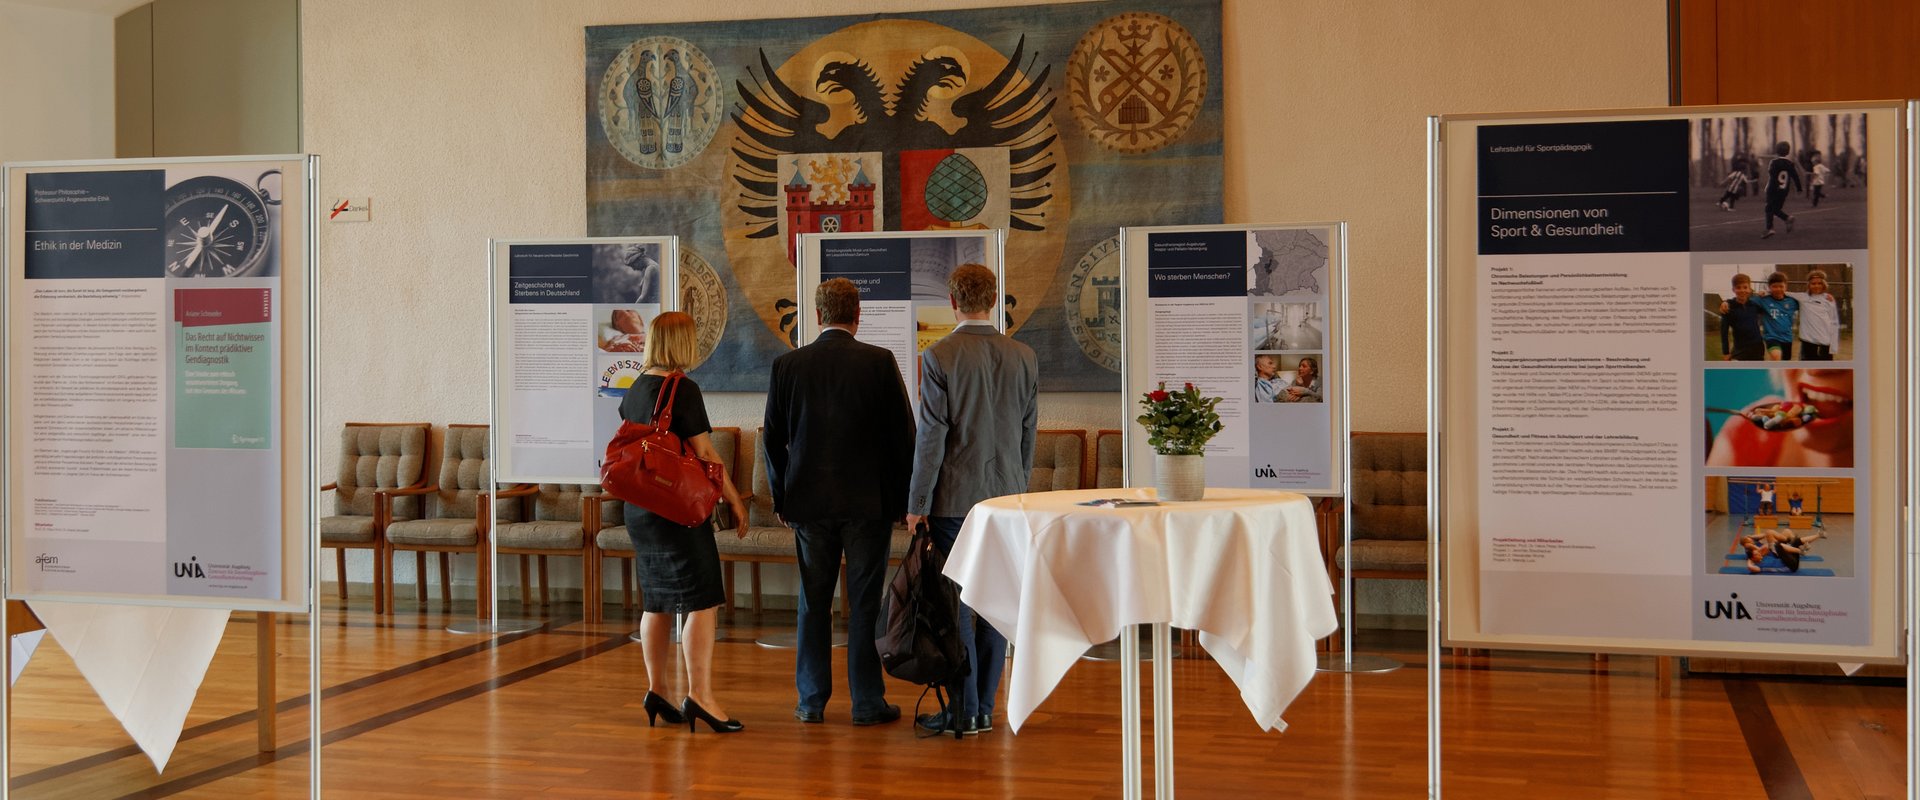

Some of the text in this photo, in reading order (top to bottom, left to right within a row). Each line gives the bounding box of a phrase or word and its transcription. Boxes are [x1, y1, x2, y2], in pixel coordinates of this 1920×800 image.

[1536, 144, 1592, 154] Sportpädagogik
[1778, 170, 1788, 188] 9
[1491, 207, 1608, 220] Dimensionen von
[180, 217, 190, 226] E
[229, 220, 239, 228] S
[1491, 223, 1623, 240] Sport & Gesundheit
[35, 240, 122, 250] Ethik in der Medizin
[168, 261, 180, 272] N
[1193, 272, 1230, 280] Menschen?
[514, 282, 553, 290] Zeitgeschichte
[185, 332, 264, 341] Das Recht auf Nichtwissen
[185, 344, 253, 354] im Kontext prädiktiver
[185, 355, 229, 366] Gendiagnostik
[35, 553, 58, 572] afem
[1791, 602, 1821, 610] Augsburg
